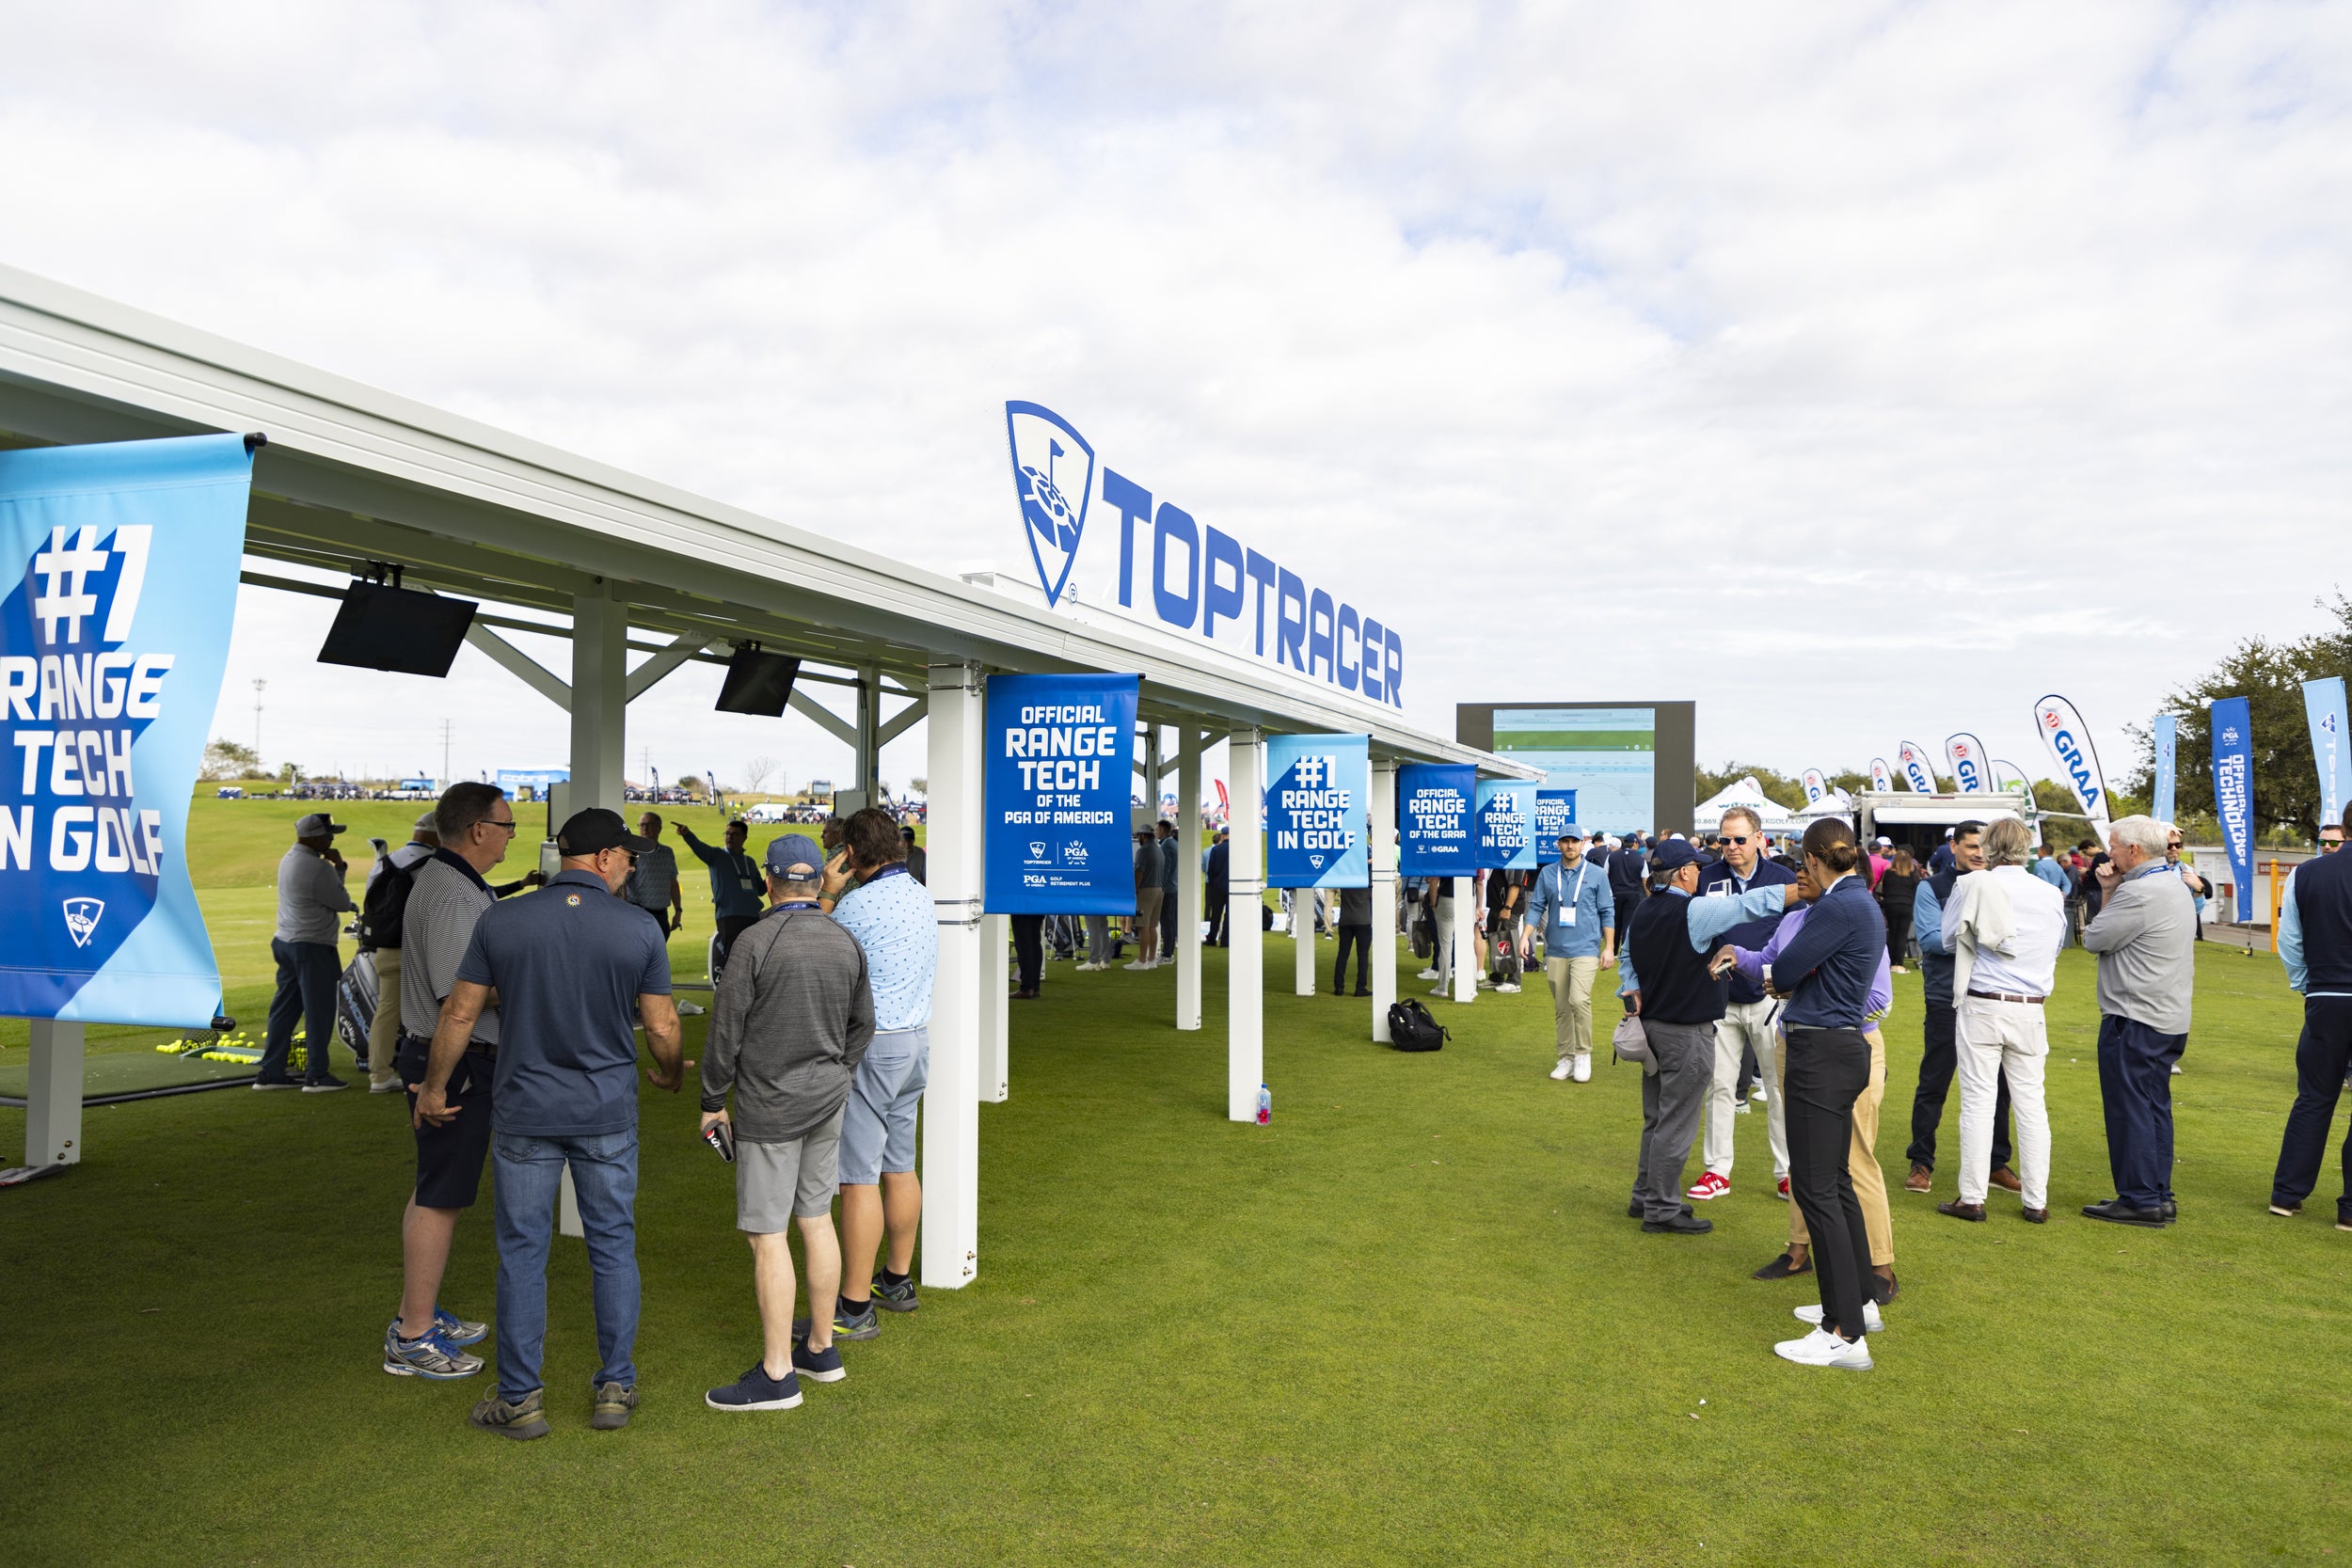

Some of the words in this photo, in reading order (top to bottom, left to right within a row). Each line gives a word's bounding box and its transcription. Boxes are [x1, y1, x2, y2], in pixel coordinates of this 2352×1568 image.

[35, 525, 153, 645] #1
[1102, 466, 1403, 709] TOPTRACER
[0, 653, 176, 721] RANGE
[1021, 705, 1105, 724] OFFICIAL
[1006, 726, 1118, 758] RANGE
[13, 730, 135, 798] TECH
[1295, 754, 1336, 788] #1
[2055, 730, 2099, 810] GRAA
[1018, 760, 1100, 791] TECH
[1958, 760, 1979, 792] GR
[2233, 754, 2247, 816] OFFICIAL
[2323, 736, 2339, 825] TOPTR
[1037, 795, 1053, 807] OF
[1056, 794, 1081, 807] THE
[1281, 789, 1351, 809] RANGE
[1417, 788, 1460, 799] OFFICIAL
[1493, 792, 1518, 812] #1
[1409, 799, 1466, 814] RANGE
[1005, 812, 1031, 824] PGA
[1035, 812, 1051, 824] OF
[1054, 811, 1113, 824] AMERICA
[1289, 810, 1343, 829] TECH
[1416, 815, 1458, 830] TECH
[1485, 812, 1527, 824] RANGE
[1536, 816, 1565, 826] TECH
[1409, 831, 1421, 839] OF
[1422, 831, 1439, 839] THE
[1489, 824, 1522, 835] TECH
[0, 805, 34, 871] N
[49, 805, 164, 877] GOLF
[1278, 831, 1298, 849] IN
[1303, 831, 1356, 849] GOLF
[1482, 836, 1495, 847] IN
[1498, 836, 1530, 847] GOLF
[1064, 847, 1089, 857] PGA
[1024, 875, 1047, 884] PGA
